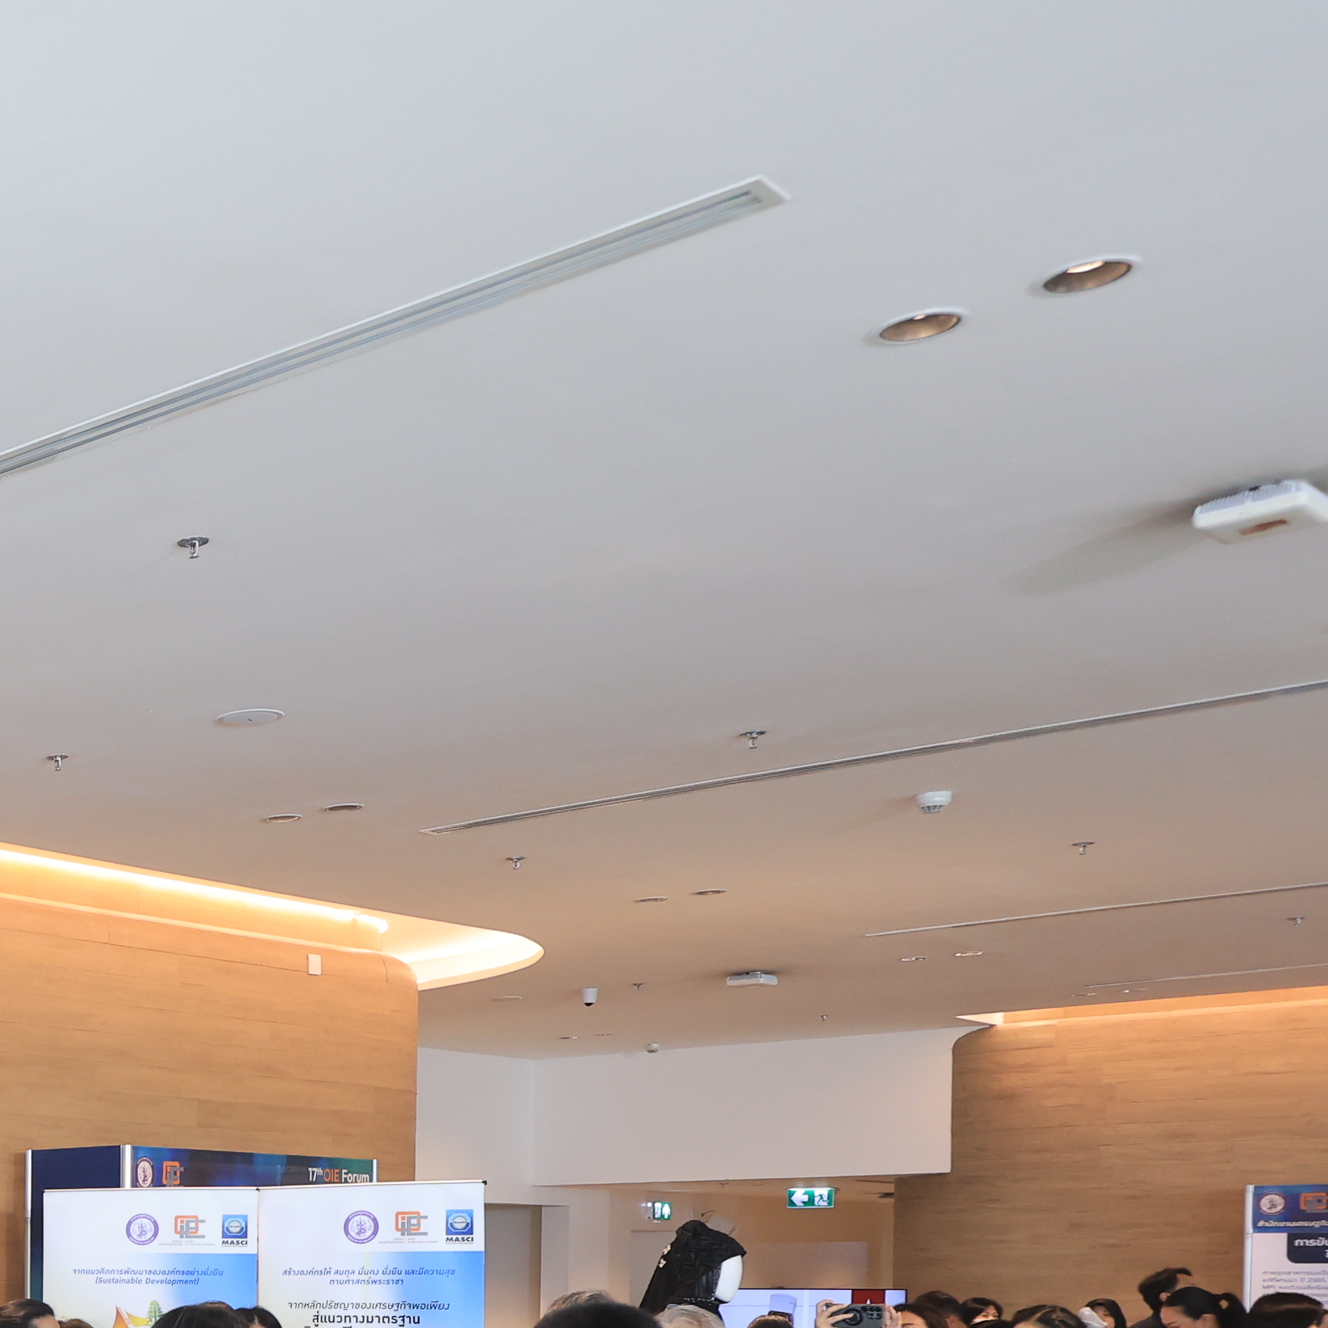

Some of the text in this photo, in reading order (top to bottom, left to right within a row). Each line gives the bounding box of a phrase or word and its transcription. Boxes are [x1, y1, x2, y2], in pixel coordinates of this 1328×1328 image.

[324, 1168, 340, 1183] OIE
[342, 1168, 370, 1183] Forum
[95, 1276, 200, 1287] (Sustainable Development)
[312, 1311, 421, 1327] สู่แนวทางมาตรฐาน
